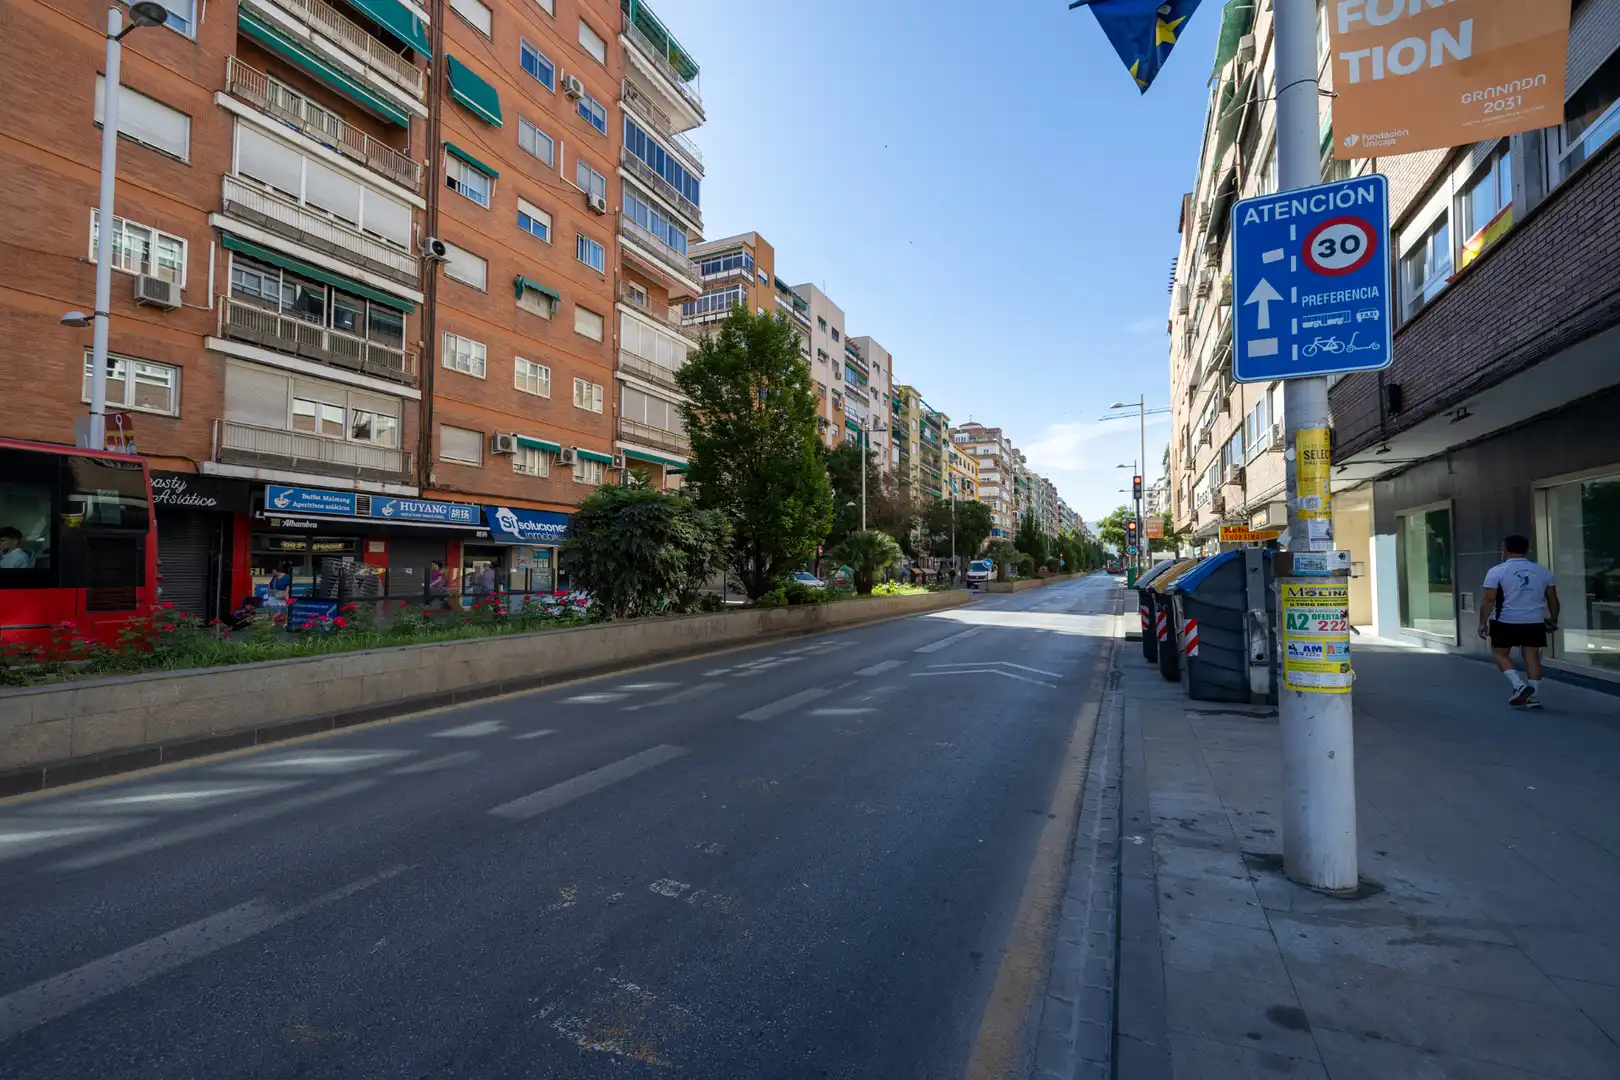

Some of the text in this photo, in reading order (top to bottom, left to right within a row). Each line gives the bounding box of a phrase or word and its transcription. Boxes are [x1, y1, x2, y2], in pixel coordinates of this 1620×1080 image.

[1339, 19, 1473, 84] TION
[1461, 74, 1547, 104] GRANADA
[1483, 95, 1523, 114] 2031
[1362, 128, 1409, 141] Fundación
[1363, 138, 1396, 148] Unicaja
[1243, 184, 1375, 226] ATENCIÓN
[1317, 234, 1361, 258] 30
[1302, 285, 1380, 307] PREFERENCIA
[1360, 311, 1377, 319] TAXI
[152, 489, 217, 506] Asiático
[292, 501, 325, 509] Aperitivos
[399, 501, 447, 515] HUYANG
[282, 519, 318, 529] Alhambra
[1287, 587, 1348, 597] MOLINA
[1286, 613, 1310, 631] A2
[1317, 620, 1348, 632] 222
[1303, 645, 1322, 653] AM
